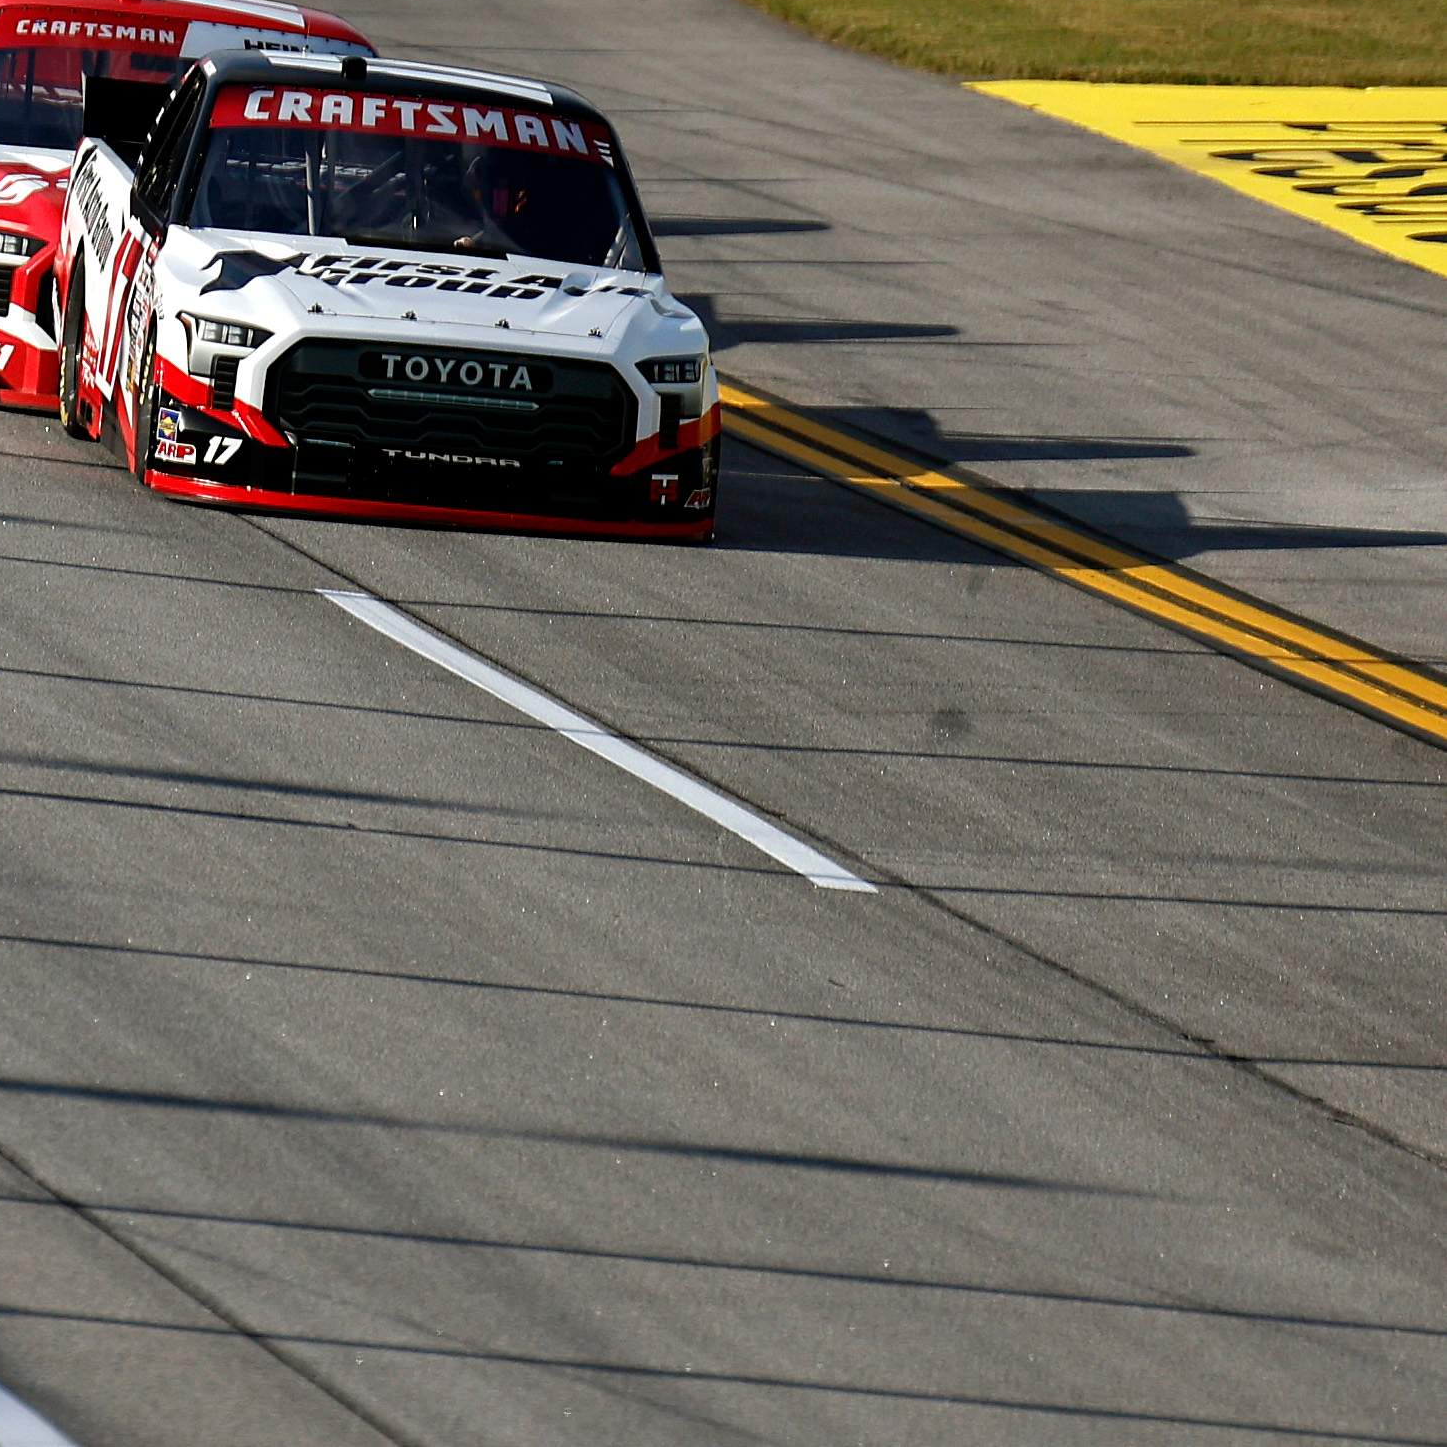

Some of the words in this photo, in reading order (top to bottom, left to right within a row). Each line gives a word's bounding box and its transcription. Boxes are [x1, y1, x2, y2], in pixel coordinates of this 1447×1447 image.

[16, 18, 175, 44] CRAFTSMAN
[243, 89, 590, 155] CRAFTSMAN
[381, 353, 533, 391] TOYOTA
[156, 440, 196, 462] ARP
[203, 435, 244, 466] 17
[382, 448, 521, 468] TUNDRA
